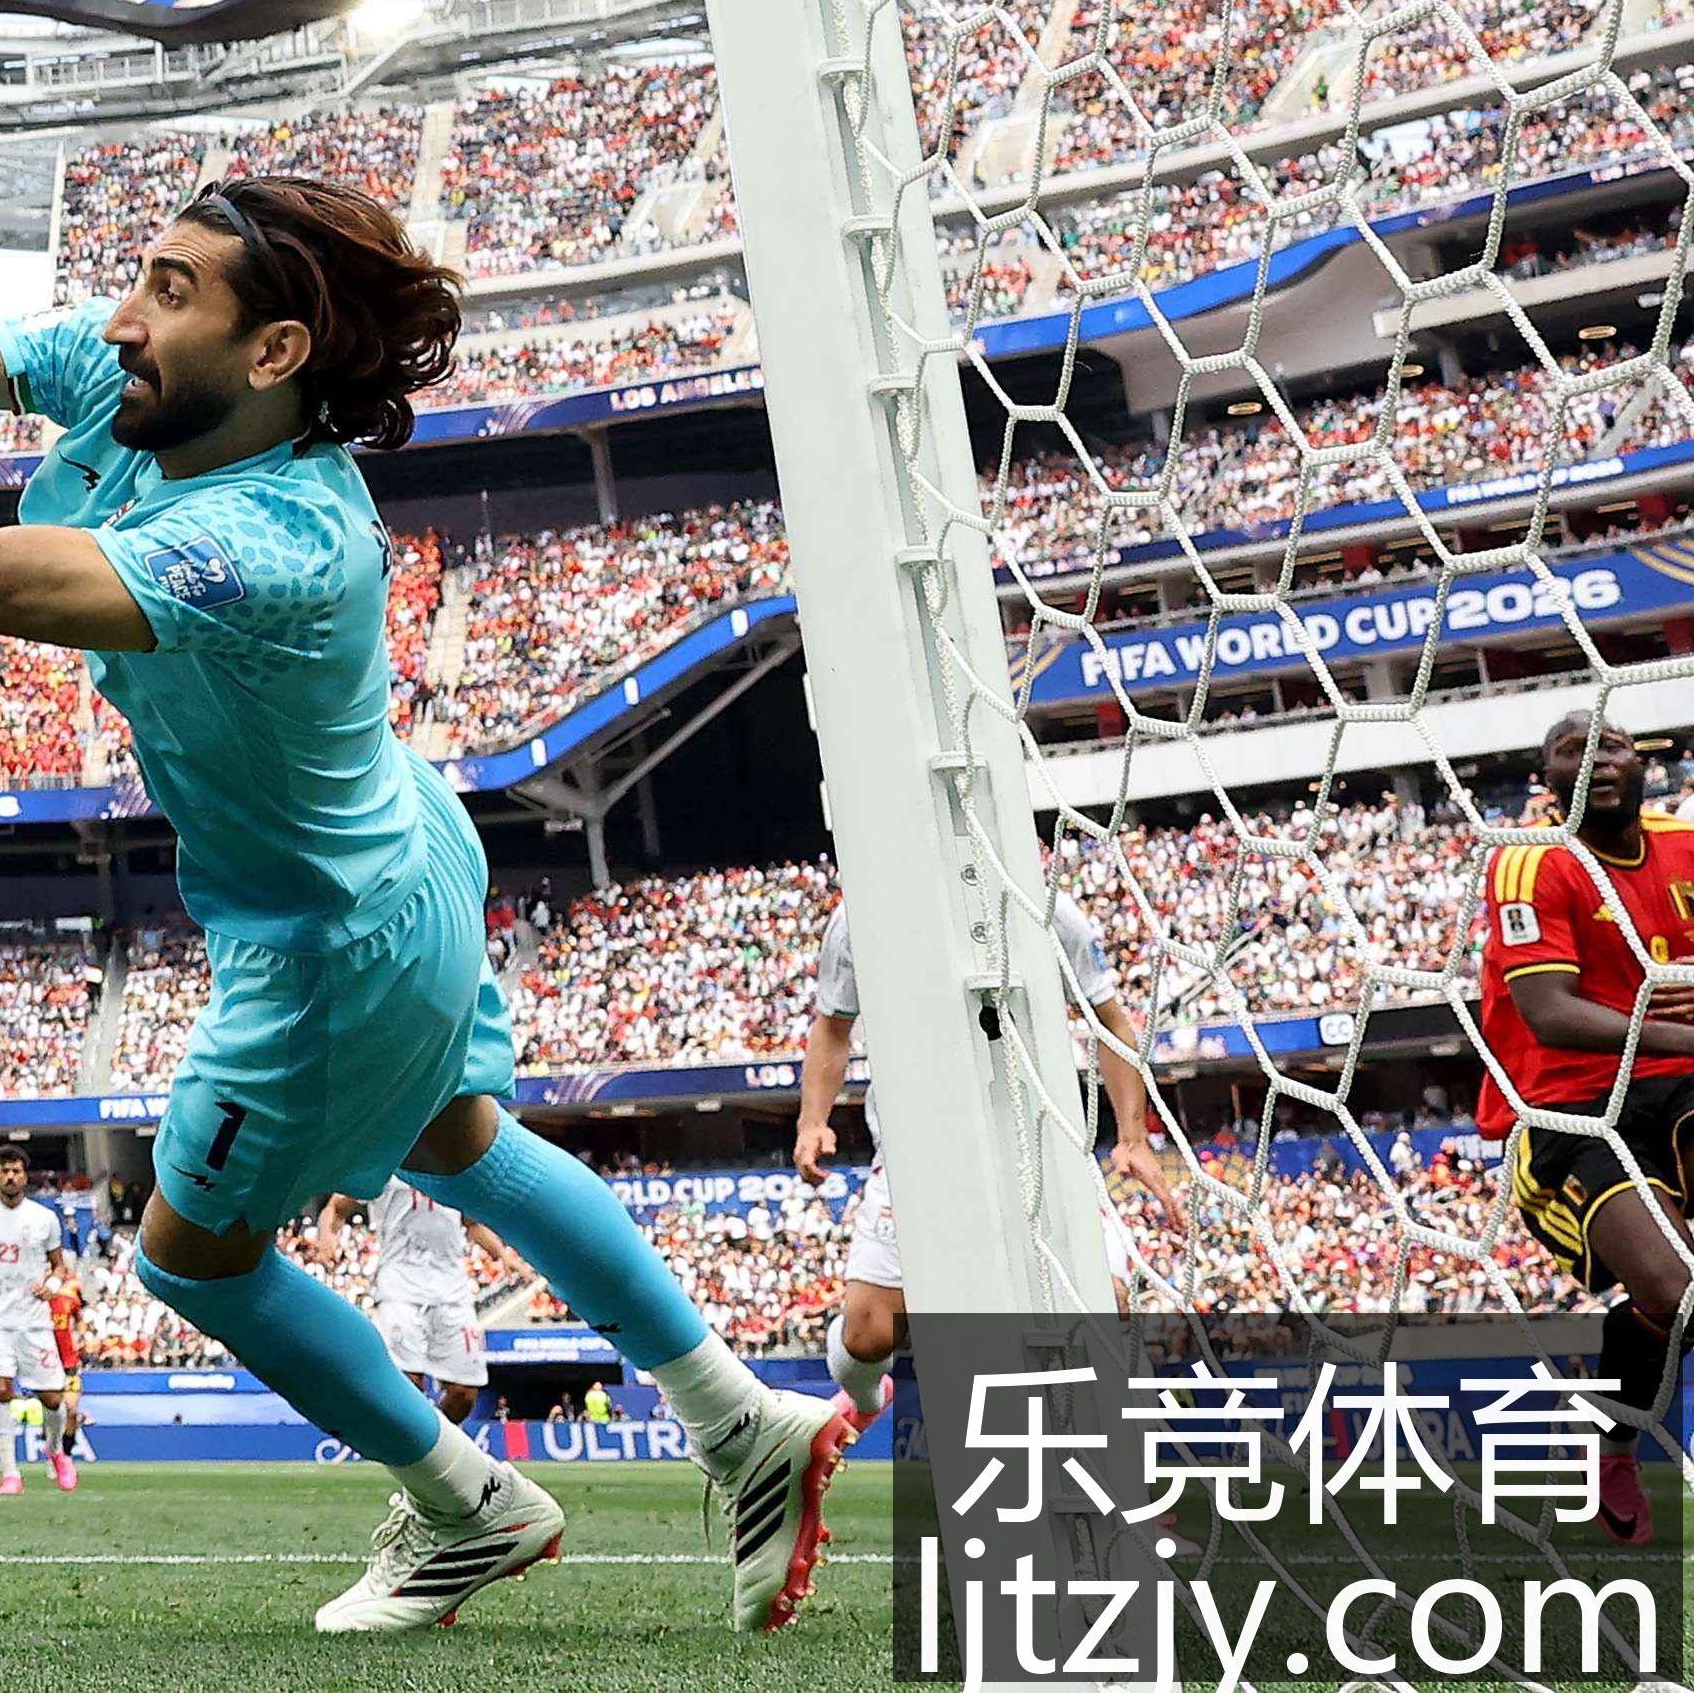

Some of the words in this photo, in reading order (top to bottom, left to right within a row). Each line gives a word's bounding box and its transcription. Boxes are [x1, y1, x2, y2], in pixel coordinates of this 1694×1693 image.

[1081, 641, 1177, 689] FIFA
[1182, 618, 1341, 670] WORLD
[1344, 600, 1445, 645] CUP
[1446, 569, 1621, 631] 2026
[206, 1101, 248, 1172] 1
[612, 1178, 671, 1205] RLD
[674, 1177, 735, 1204] CUP
[543, 1422, 692, 1461] ULTR
